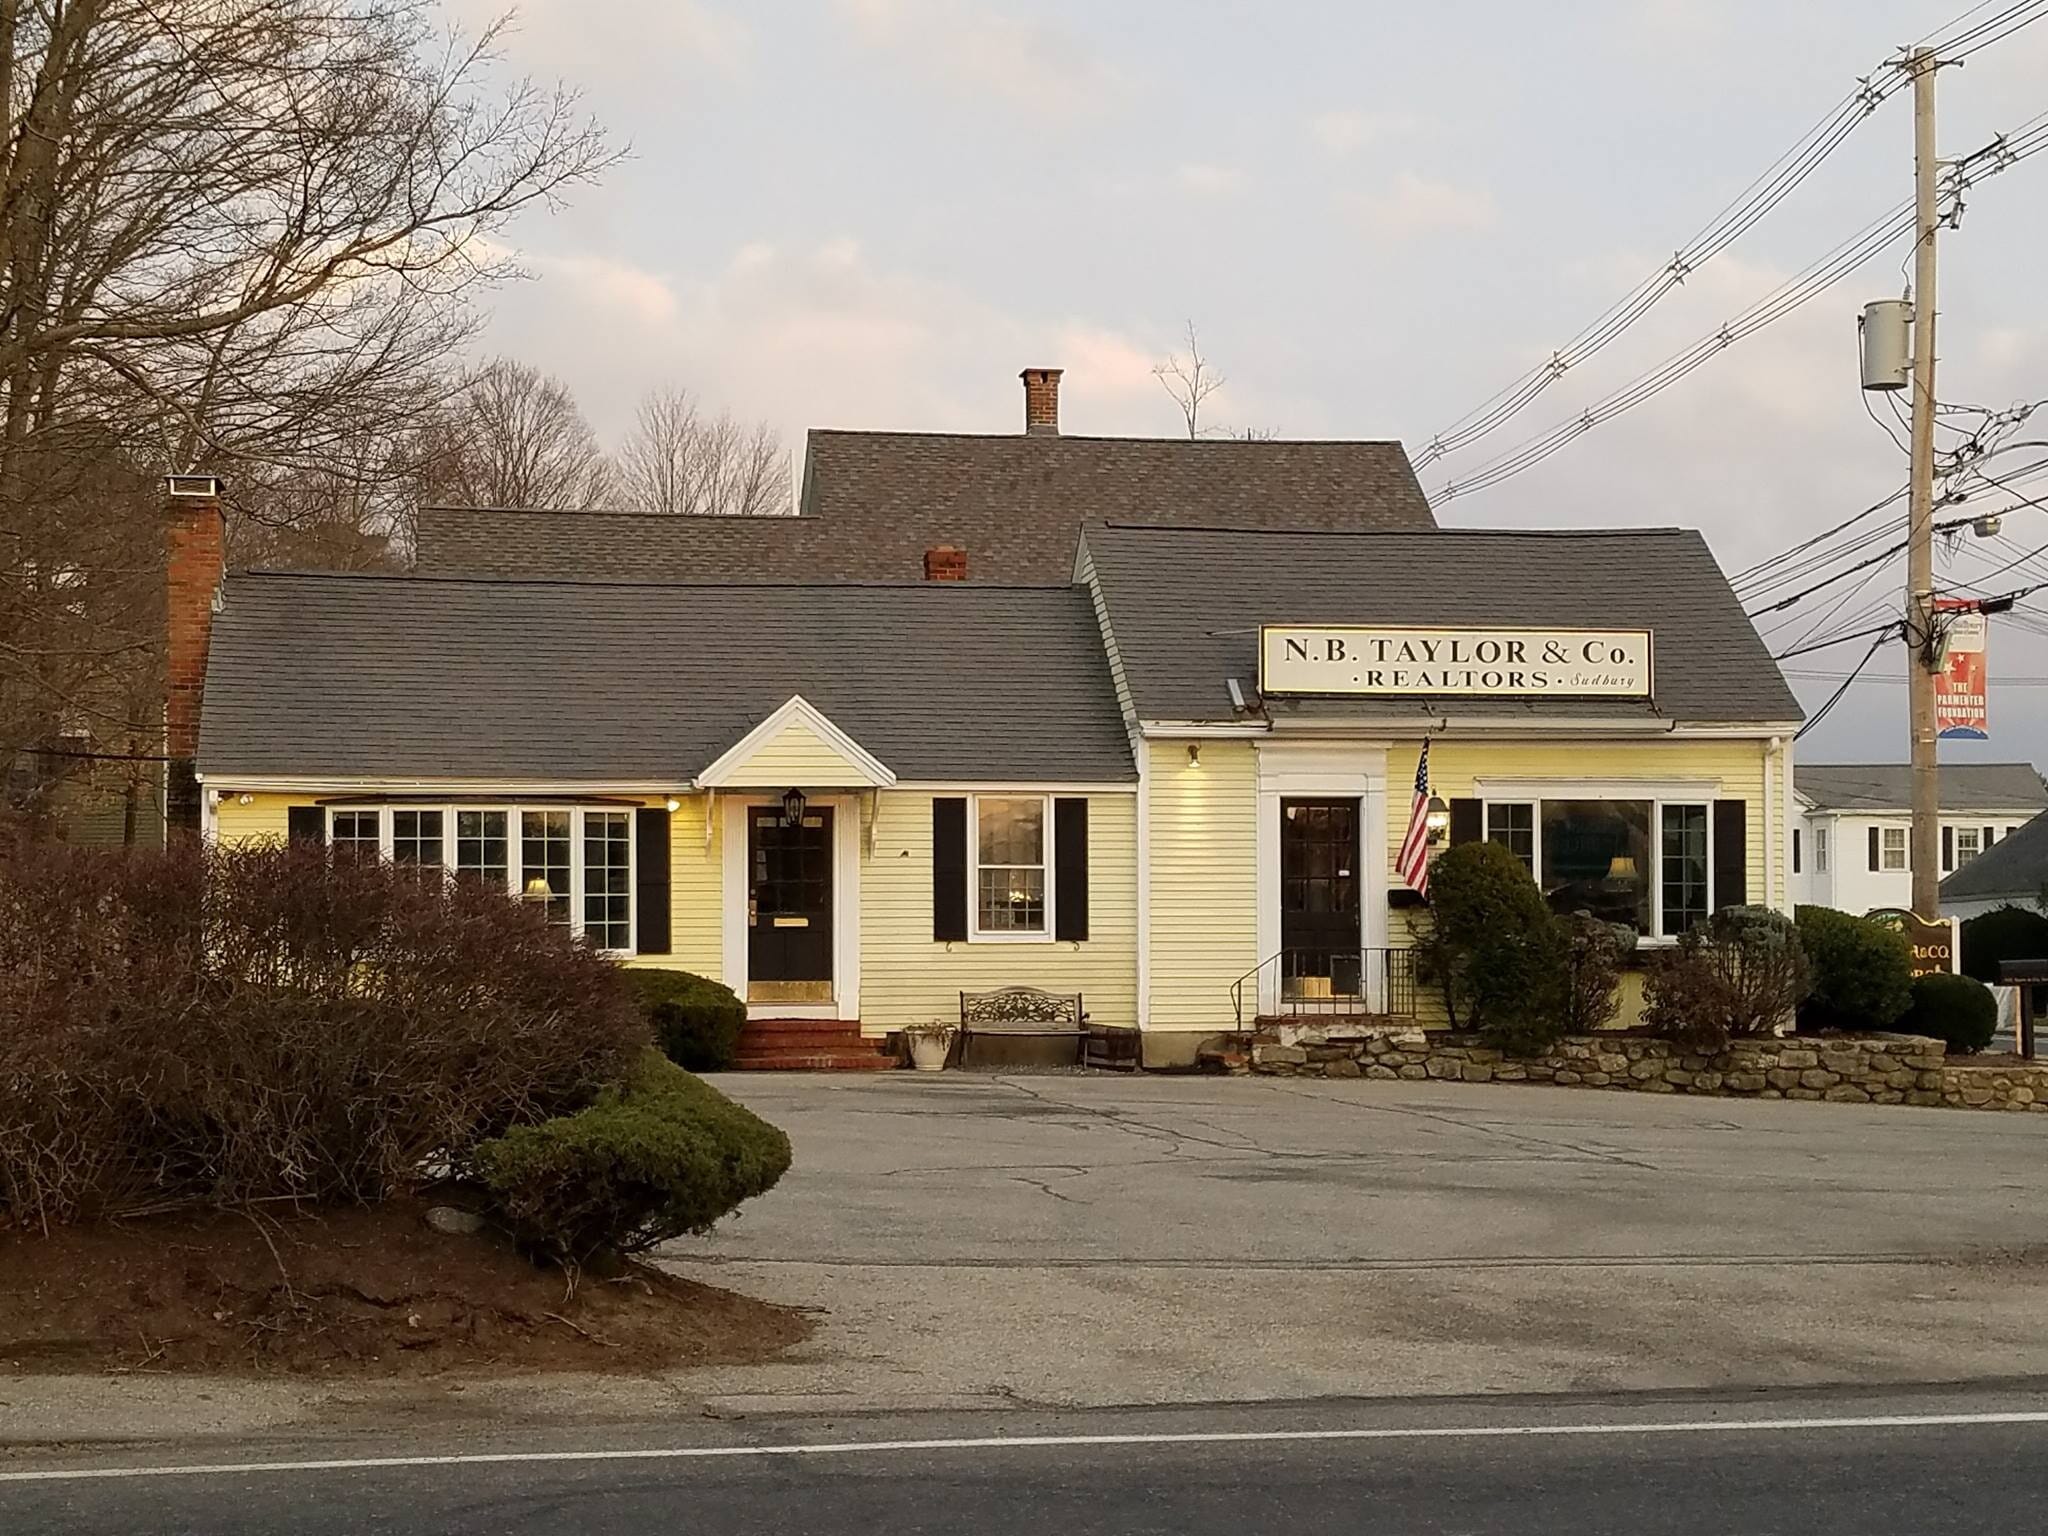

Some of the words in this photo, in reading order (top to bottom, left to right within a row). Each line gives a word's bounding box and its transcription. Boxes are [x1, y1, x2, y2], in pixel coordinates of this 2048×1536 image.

[1370, 639, 1527, 664] TAYLOR
[1541, 640, 1571, 664] &
[1570, 672, 1634, 689] Sudbury
[1952, 682, 1968, 693] THE
[1938, 707, 1984, 719] FOUNDATION
